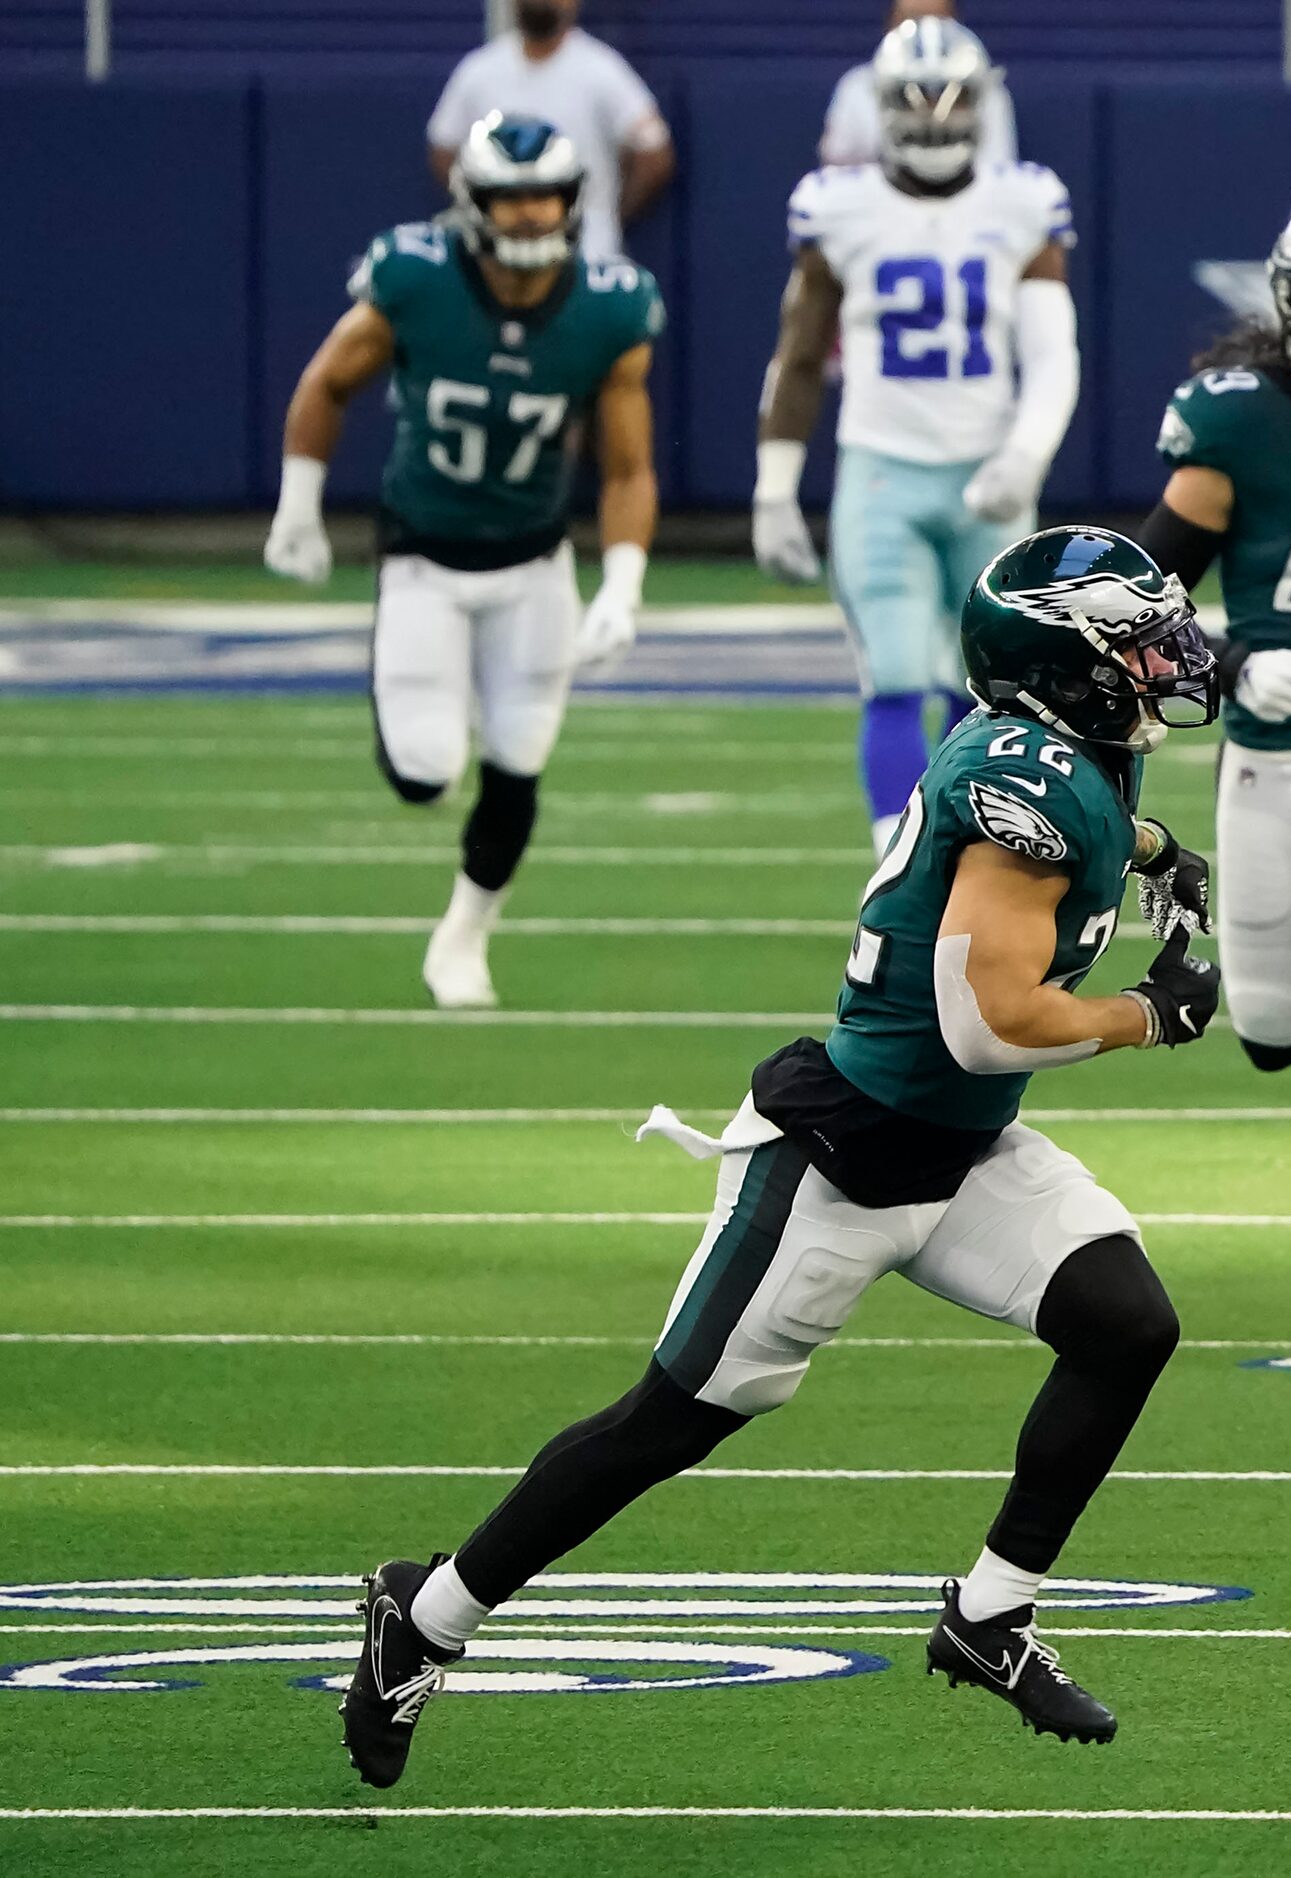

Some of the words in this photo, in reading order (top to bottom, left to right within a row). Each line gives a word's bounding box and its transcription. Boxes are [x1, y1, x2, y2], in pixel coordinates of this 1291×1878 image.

[876, 256, 994, 379] 21
[426, 377, 569, 484] 57
[987, 716, 1076, 778] 22
